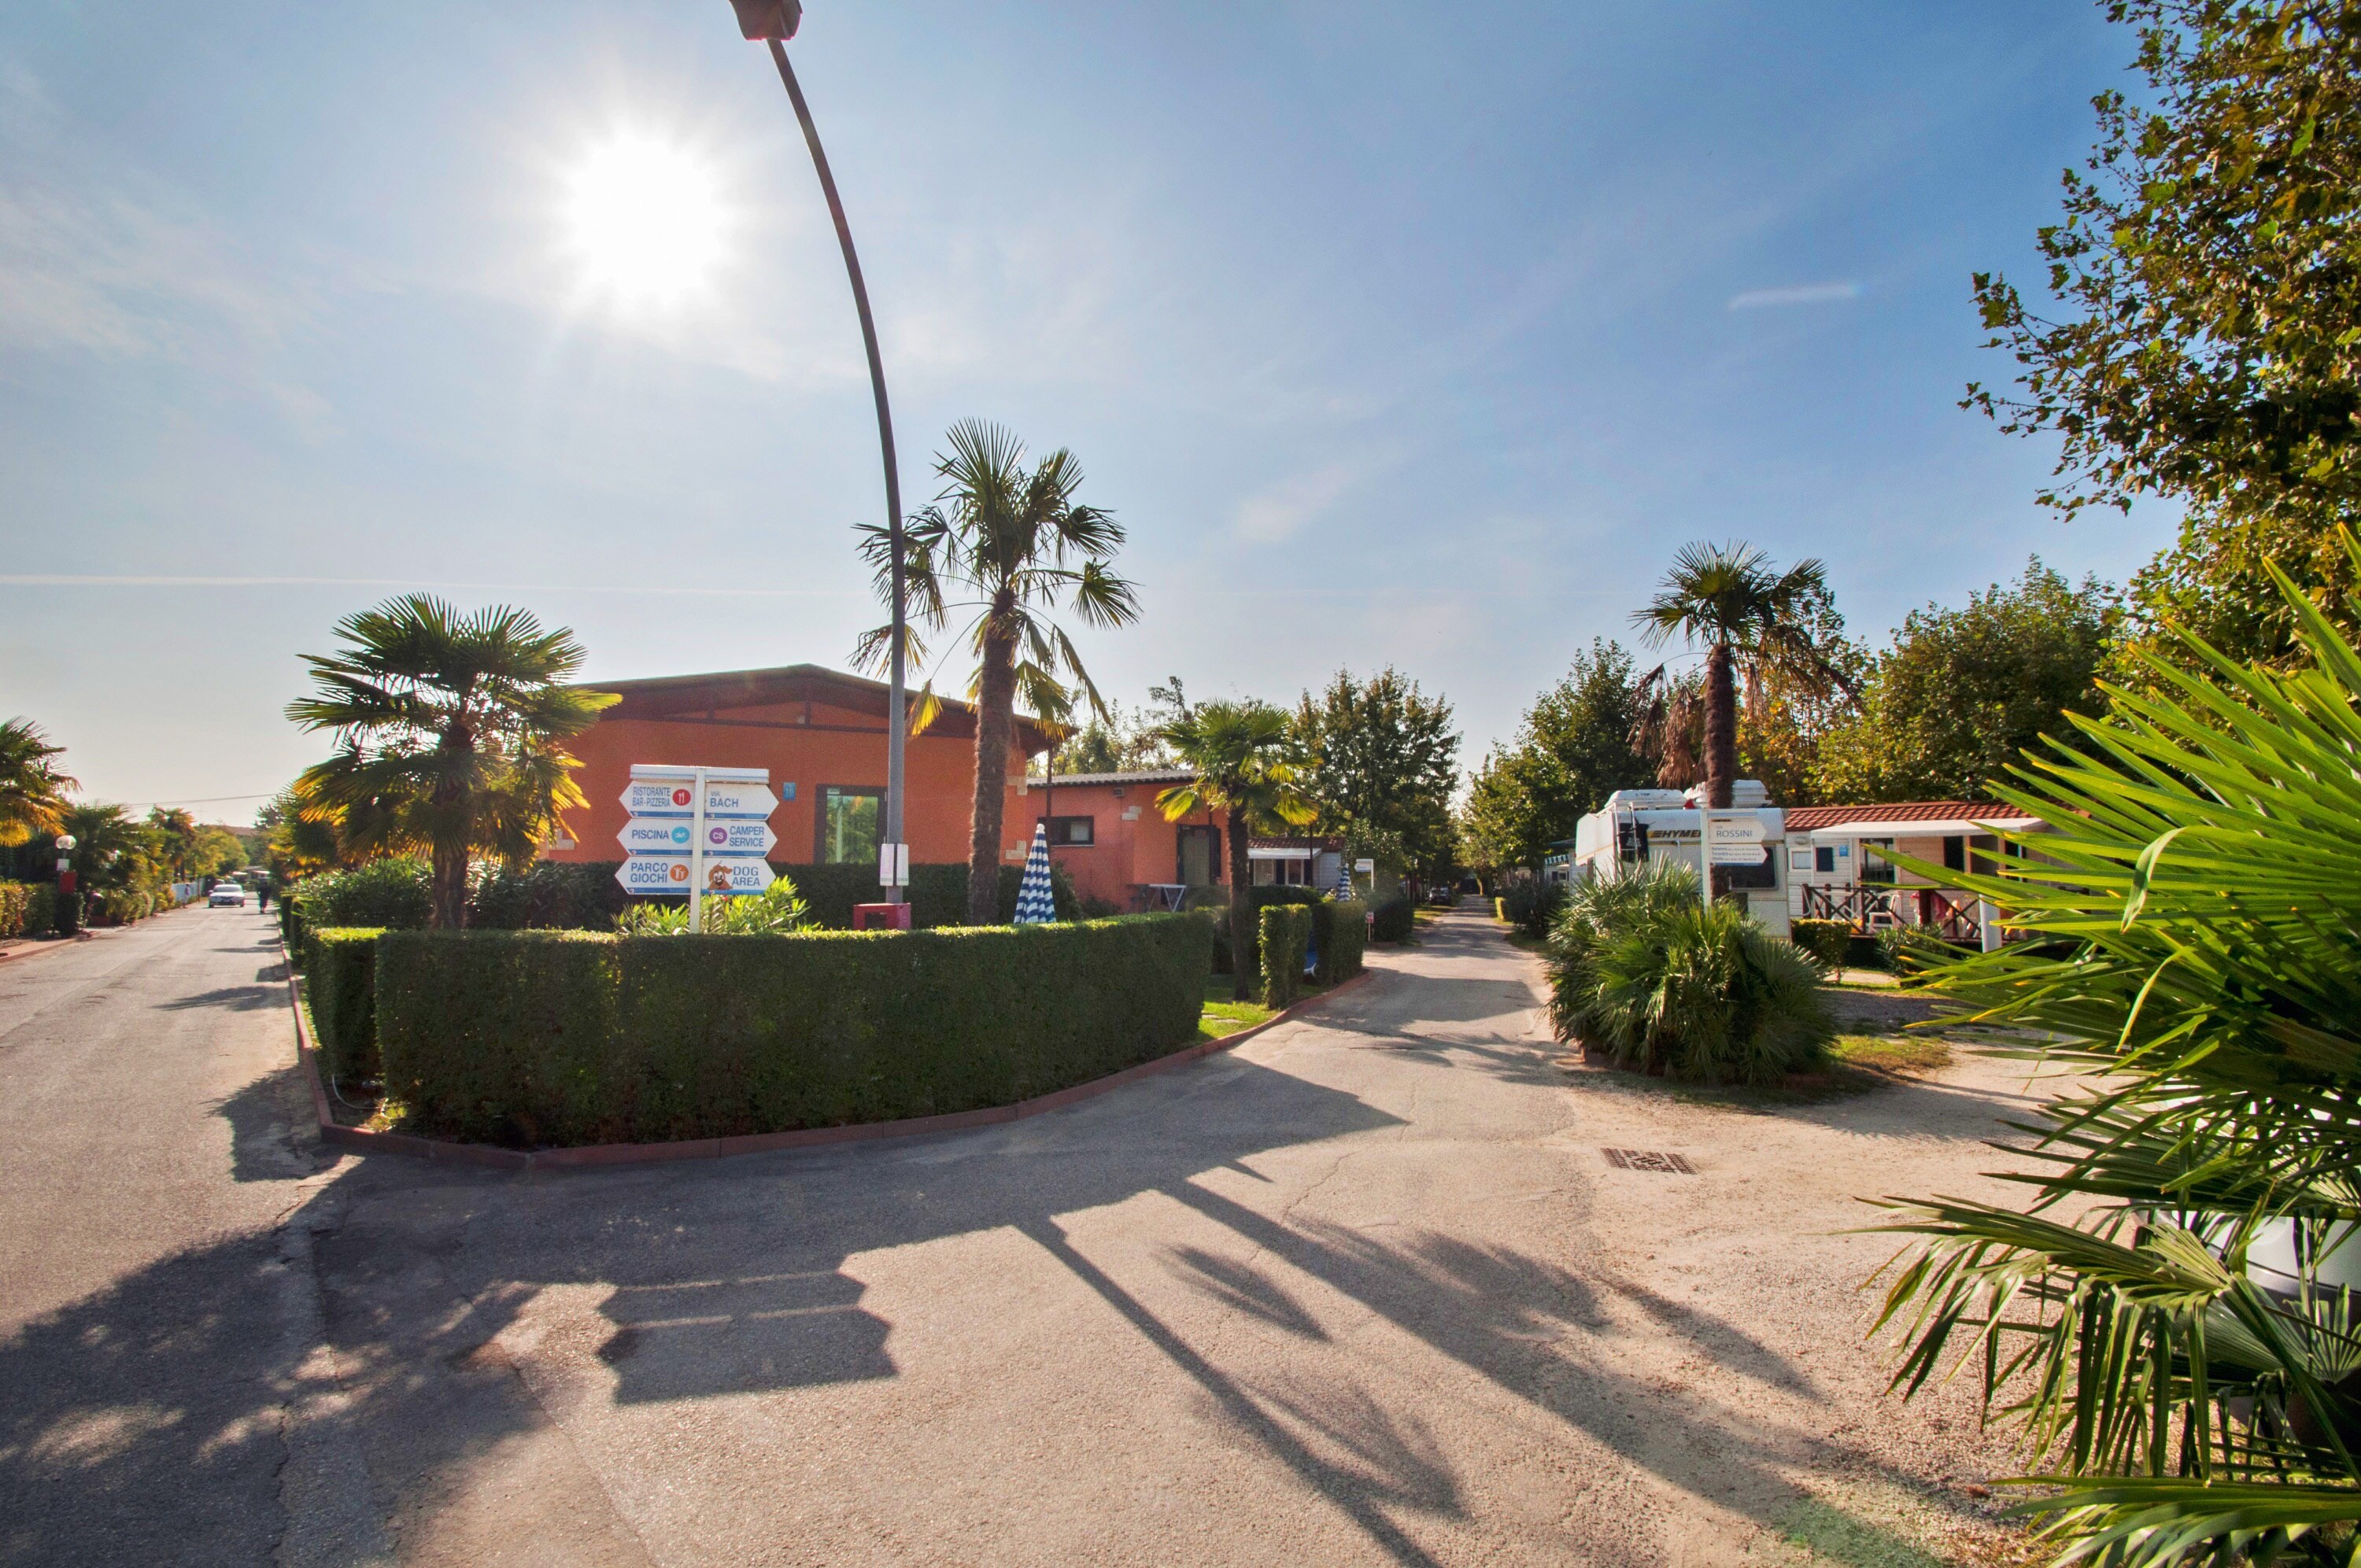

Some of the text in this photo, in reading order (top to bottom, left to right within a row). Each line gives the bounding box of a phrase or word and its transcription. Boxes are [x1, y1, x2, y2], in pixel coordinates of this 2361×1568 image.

[633, 787, 671, 797] RISTORANTE
[710, 798, 739, 807] BACH
[632, 830, 669, 839] PISCINA
[730, 826, 764, 836] CAMPER
[729, 837, 764, 847] SERVICE
[630, 862, 668, 873] PARCO
[733, 866, 759, 876] DOG
[630, 873, 668, 883] GIOCHI
[732, 876, 760, 886] AREA
